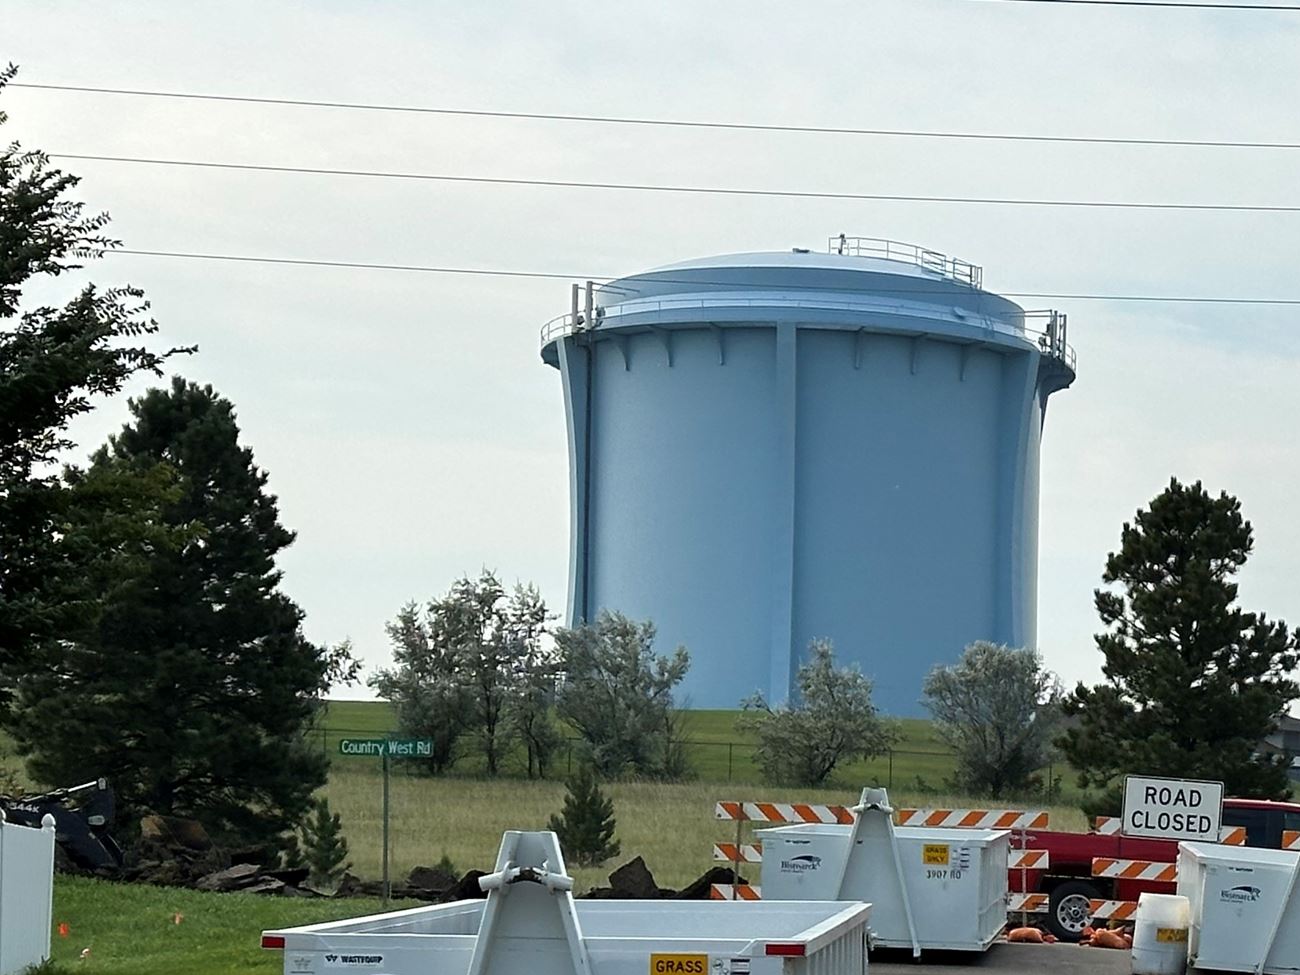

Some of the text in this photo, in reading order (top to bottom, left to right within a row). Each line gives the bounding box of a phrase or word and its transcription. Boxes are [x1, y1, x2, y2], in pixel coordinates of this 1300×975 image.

[341, 740, 432, 756] Country West Rd
[1145, 786, 1201, 807] ROAD
[1131, 810, 1211, 834] CLOSED
[926, 869, 947, 880] 3907
[656, 960, 703, 973] GRASS
